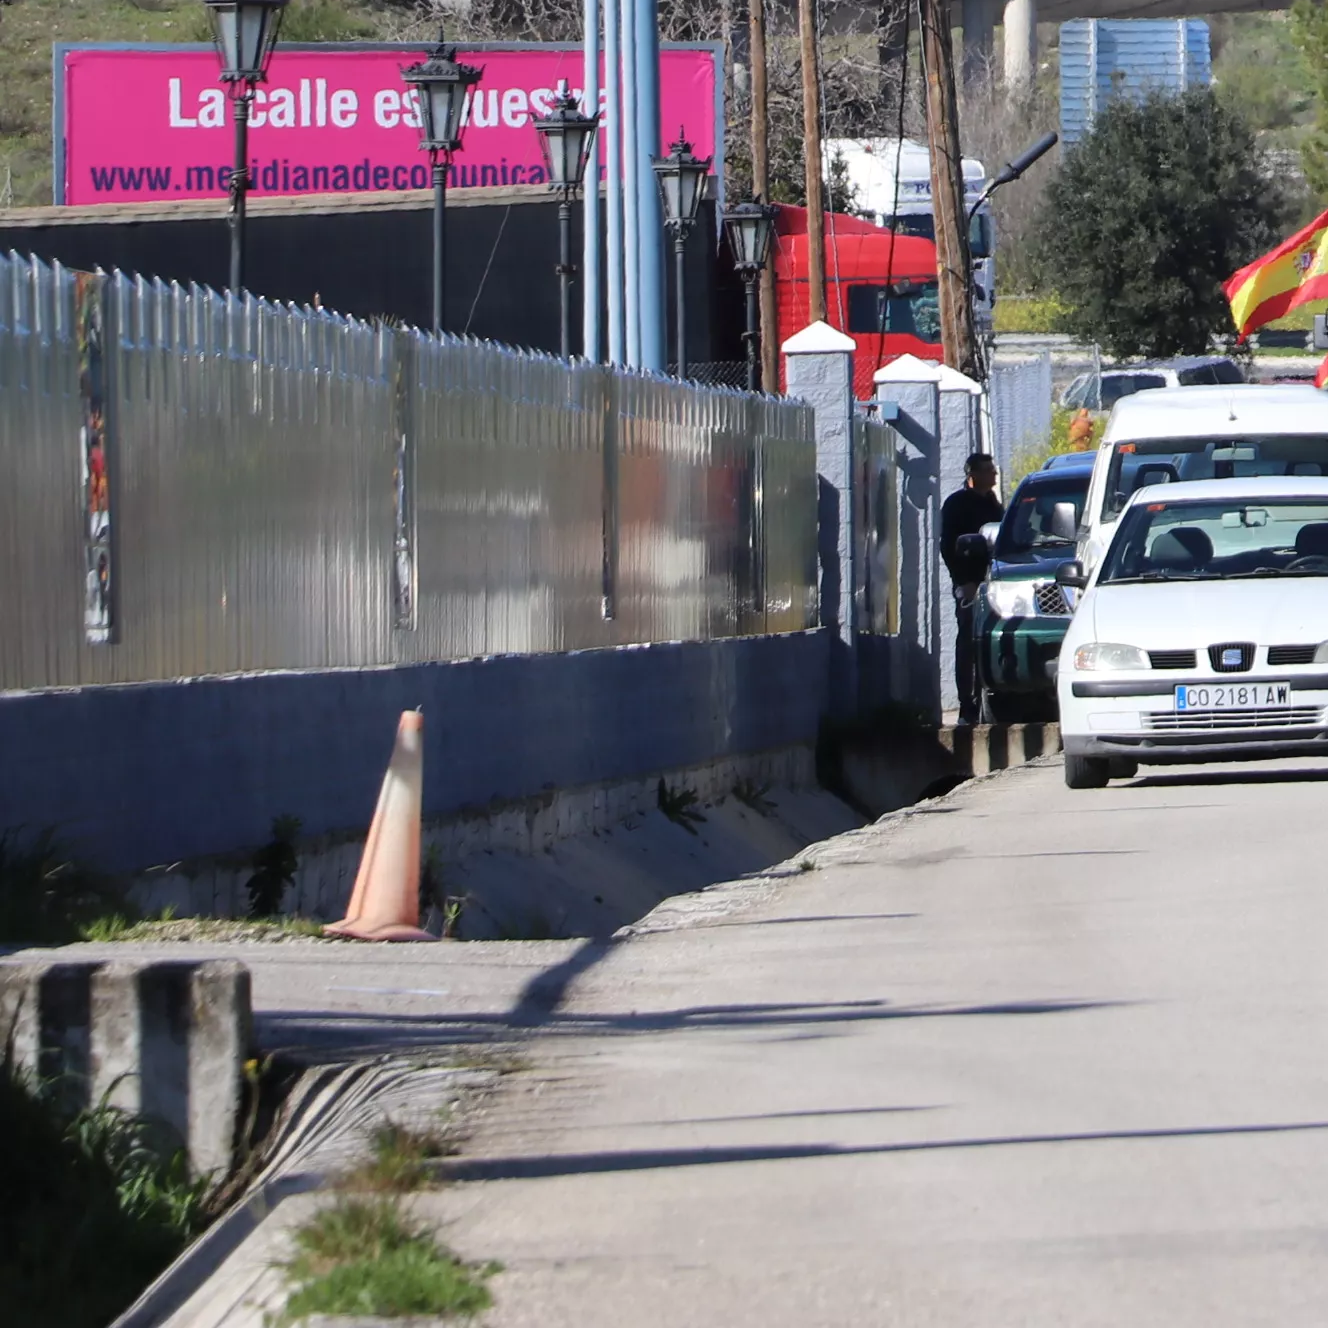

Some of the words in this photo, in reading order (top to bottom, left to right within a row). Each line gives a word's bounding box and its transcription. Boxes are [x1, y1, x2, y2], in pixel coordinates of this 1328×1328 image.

[169, 78, 226, 128] La
[246, 78, 359, 128] calle
[373, 88, 426, 129] es
[1187, 688, 1210, 707] CO
[1214, 686, 1258, 706] 2181
[1265, 685, 1288, 705] AW
